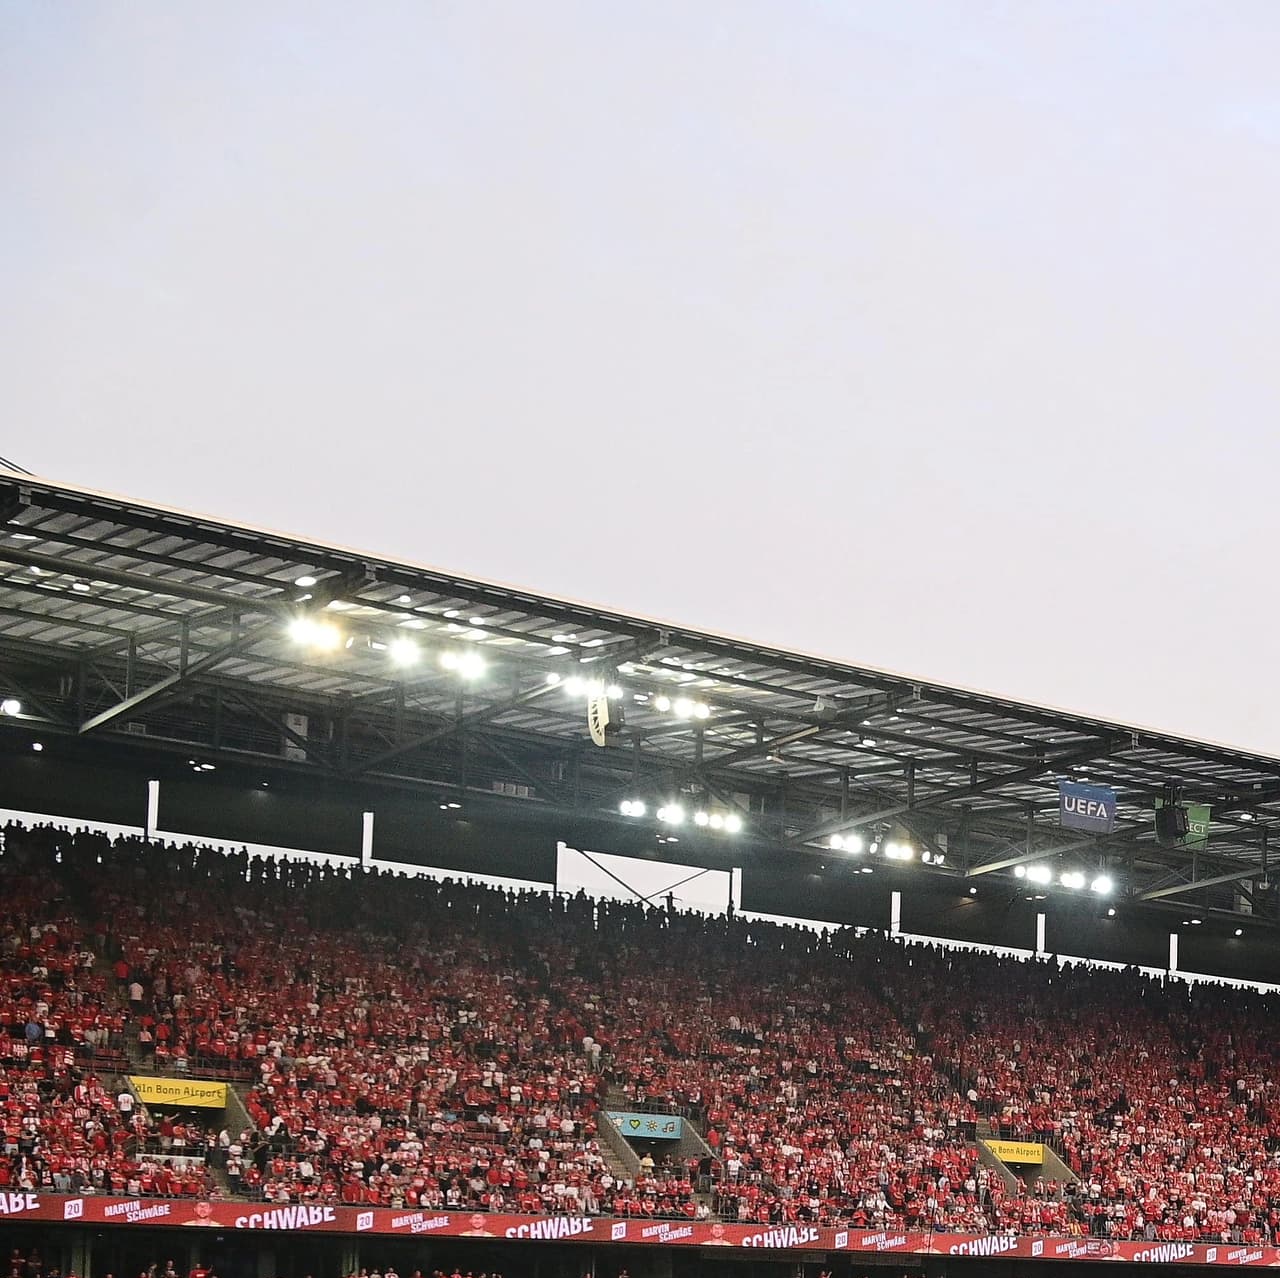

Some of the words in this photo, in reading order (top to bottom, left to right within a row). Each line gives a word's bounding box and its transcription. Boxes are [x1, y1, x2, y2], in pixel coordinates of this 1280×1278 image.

[1064, 796, 1107, 817] UEFA
[156, 1085, 180, 1094] Bonn
[184, 1087, 222, 1098] Airport
[67, 1203, 80, 1215] 20
[104, 1200, 140, 1217] MARVIN
[359, 1216, 370, 1227] 20
[392, 1213, 424, 1228] MARVIN
[614, 1226, 623, 1237] 20
[642, 1223, 669, 1237] MARVIN
[861, 1231, 886, 1247] MARVIN
